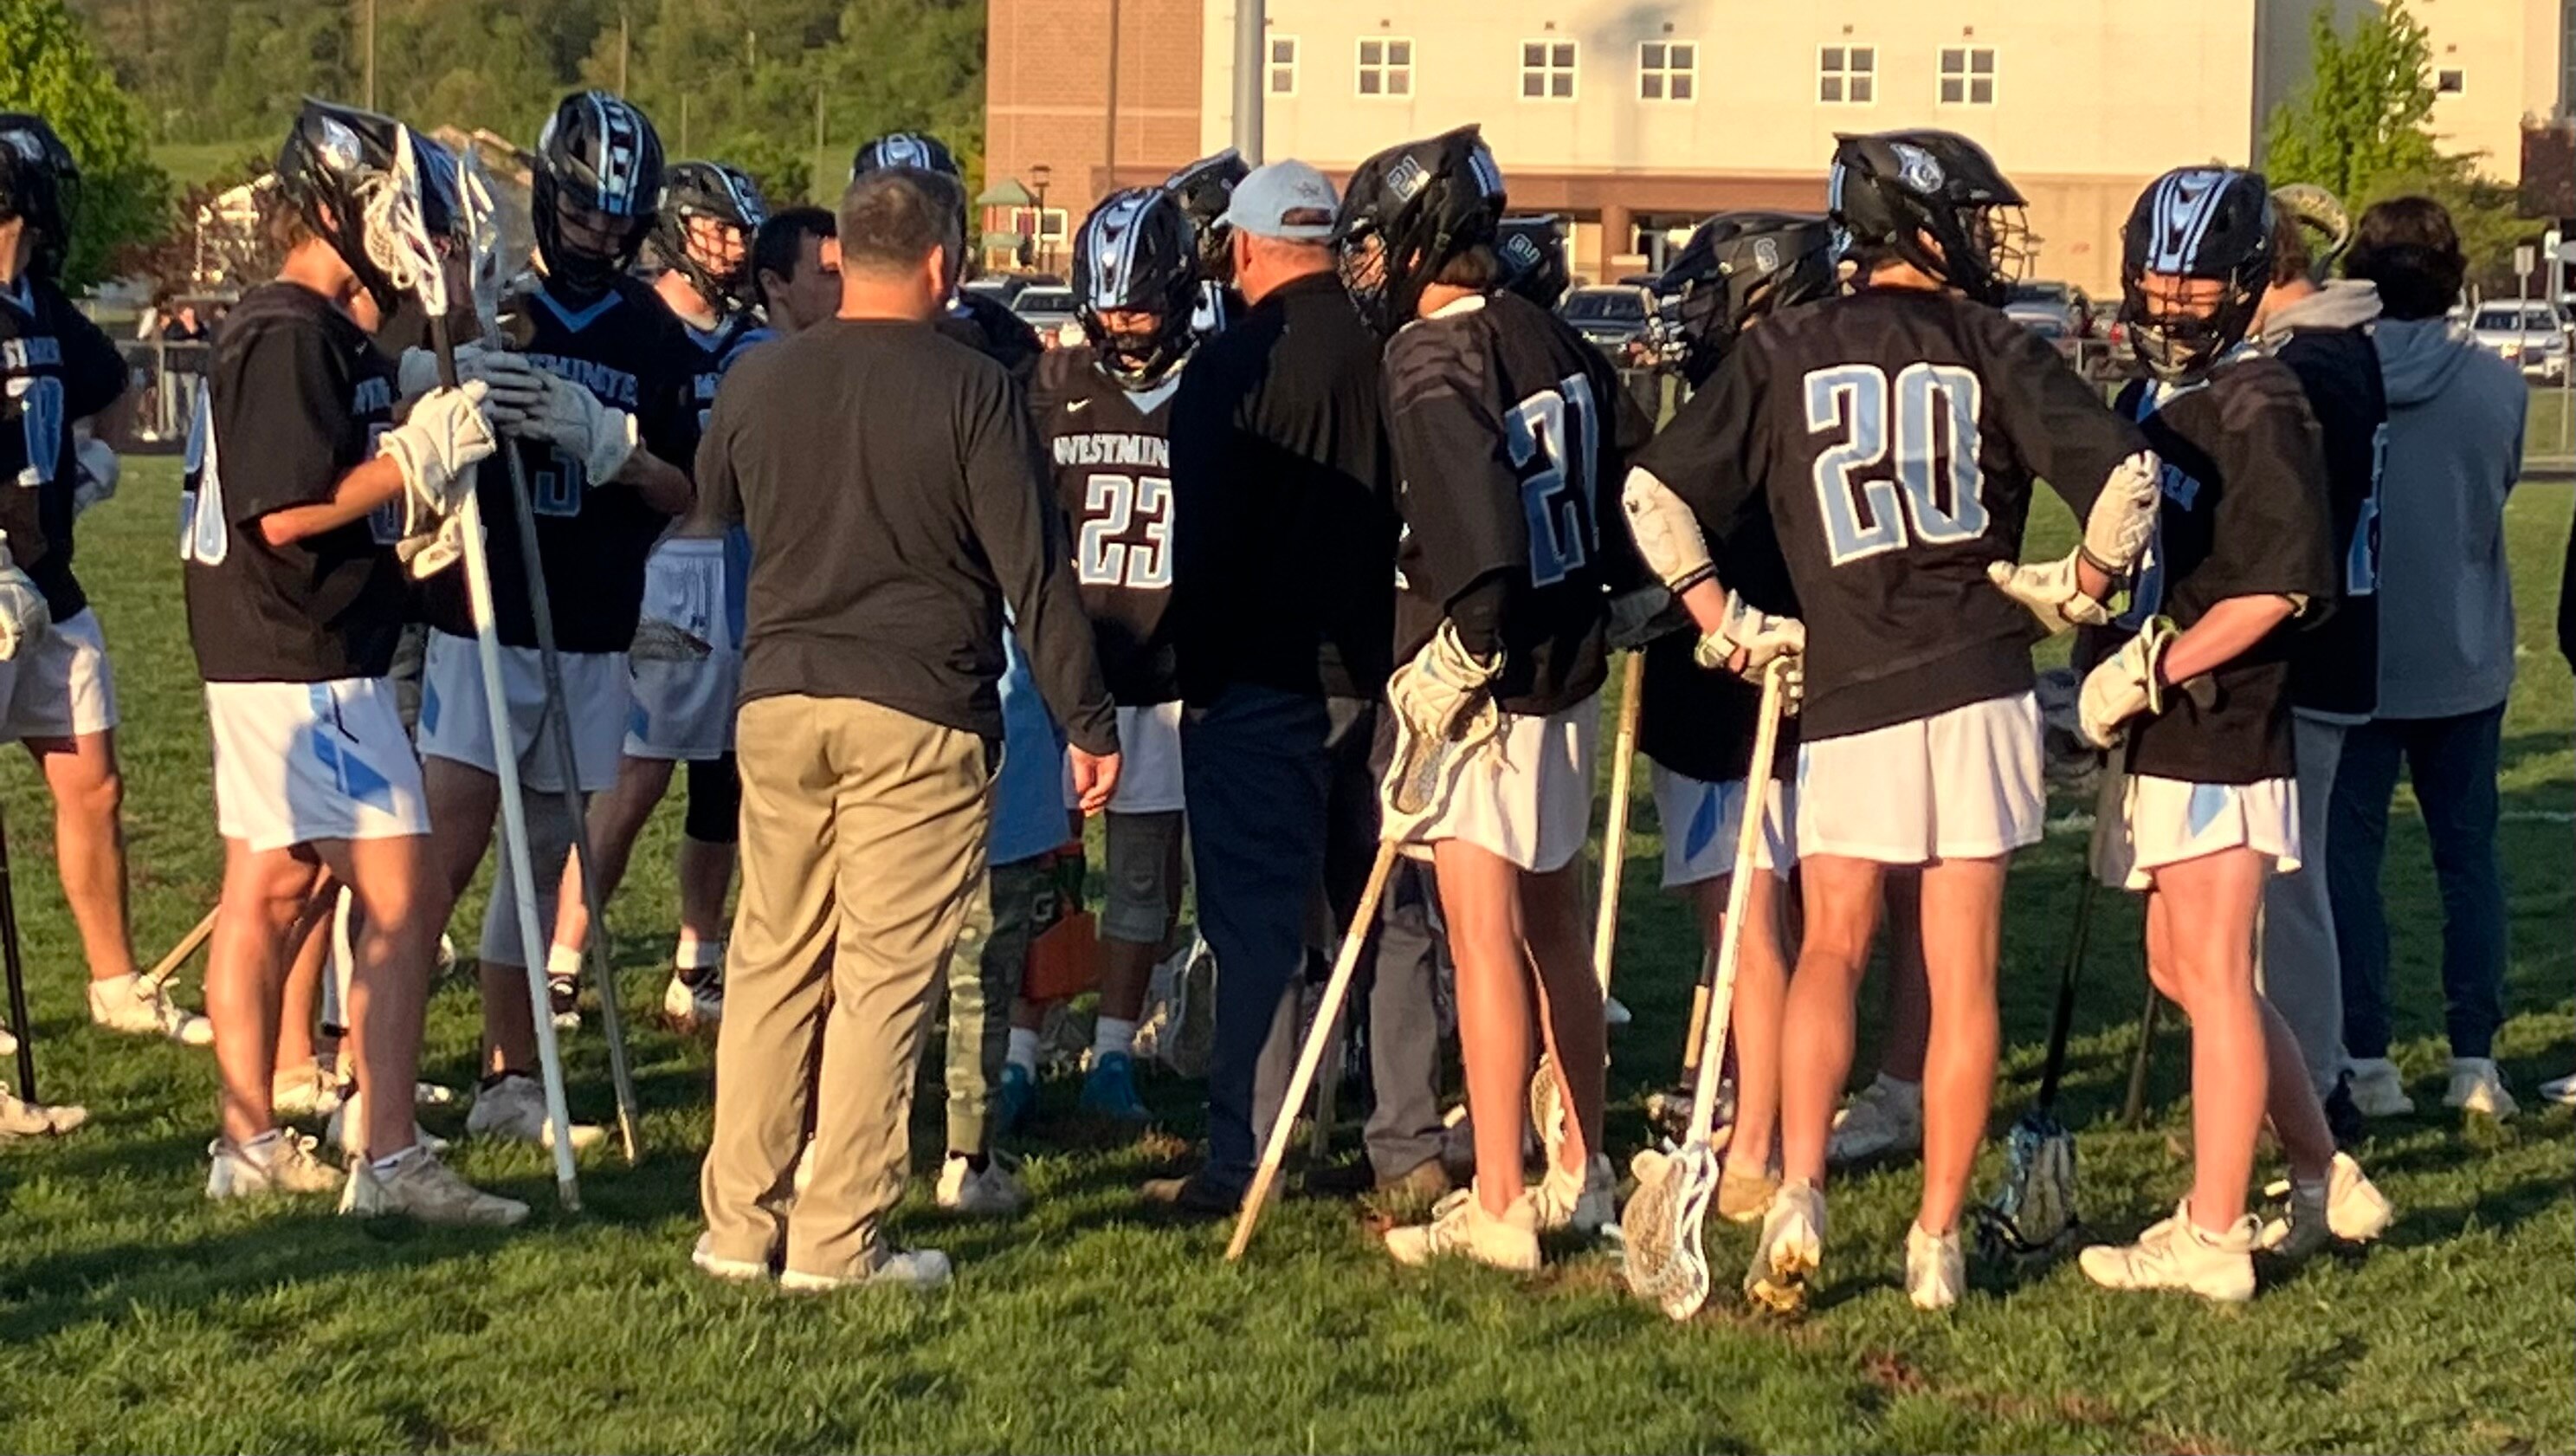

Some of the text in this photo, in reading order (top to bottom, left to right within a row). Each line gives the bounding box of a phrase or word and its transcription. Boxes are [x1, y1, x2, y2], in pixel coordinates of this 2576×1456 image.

[1387, 154, 1430, 202] 21
[1053, 433, 1170, 469] WESTMIN
[1505, 372, 1600, 589] 21
[1804, 362, 1991, 567] 20
[1079, 474, 1175, 588] 23
